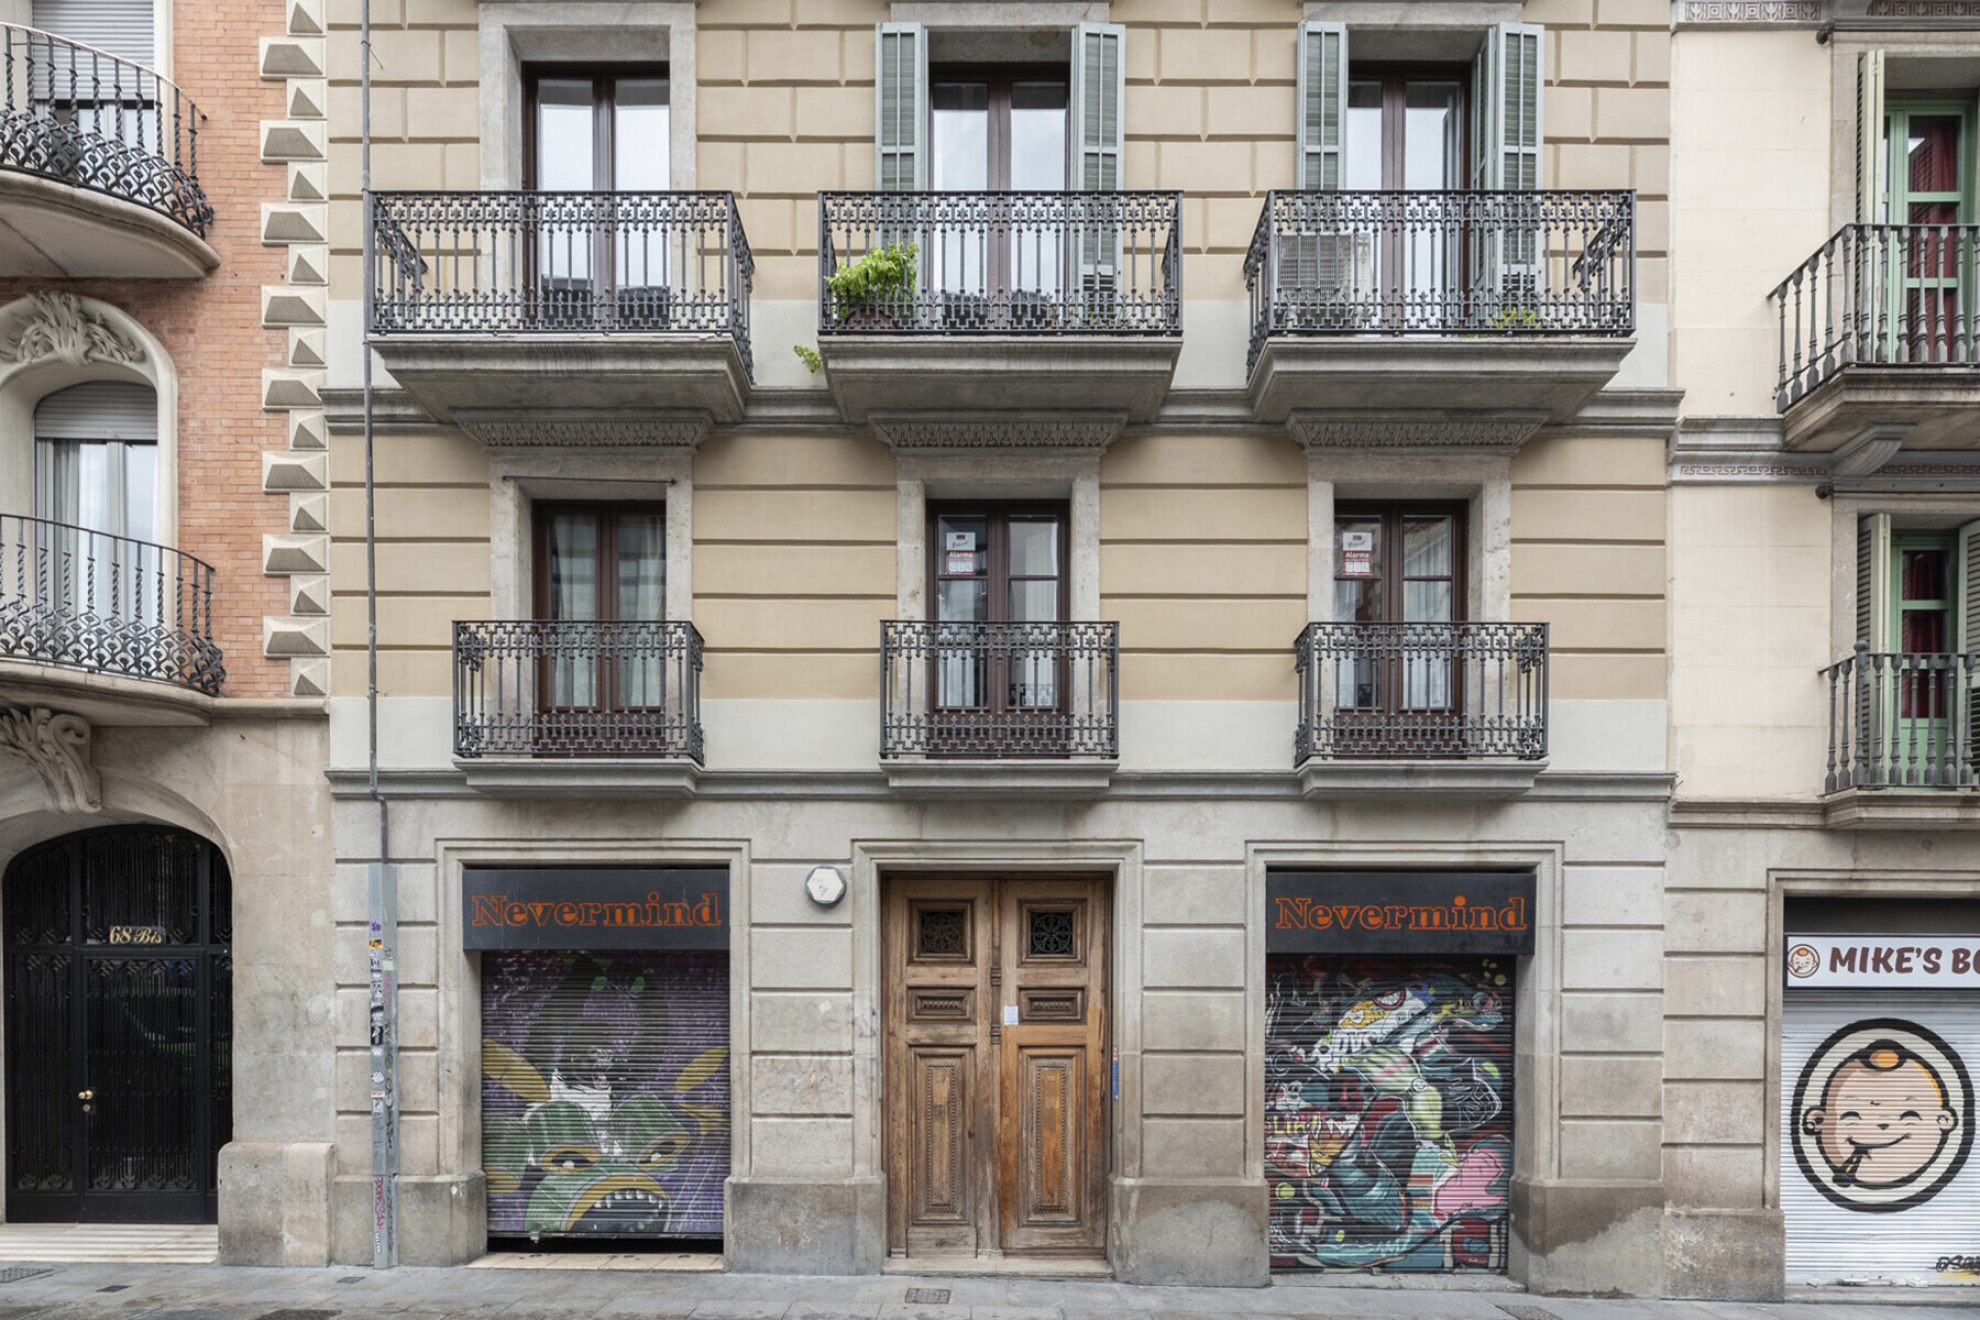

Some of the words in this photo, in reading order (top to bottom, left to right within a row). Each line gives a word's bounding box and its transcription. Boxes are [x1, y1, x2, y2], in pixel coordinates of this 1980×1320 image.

[1345, 550, 1370, 558] Alarma
[471, 891, 722, 926] Nevermind
[1275, 895, 1527, 930] Nevermind
[110, 925, 132, 945] 68
[133, 926, 162, 945] Bis
[1829, 946, 1943, 974] MIKE'S
